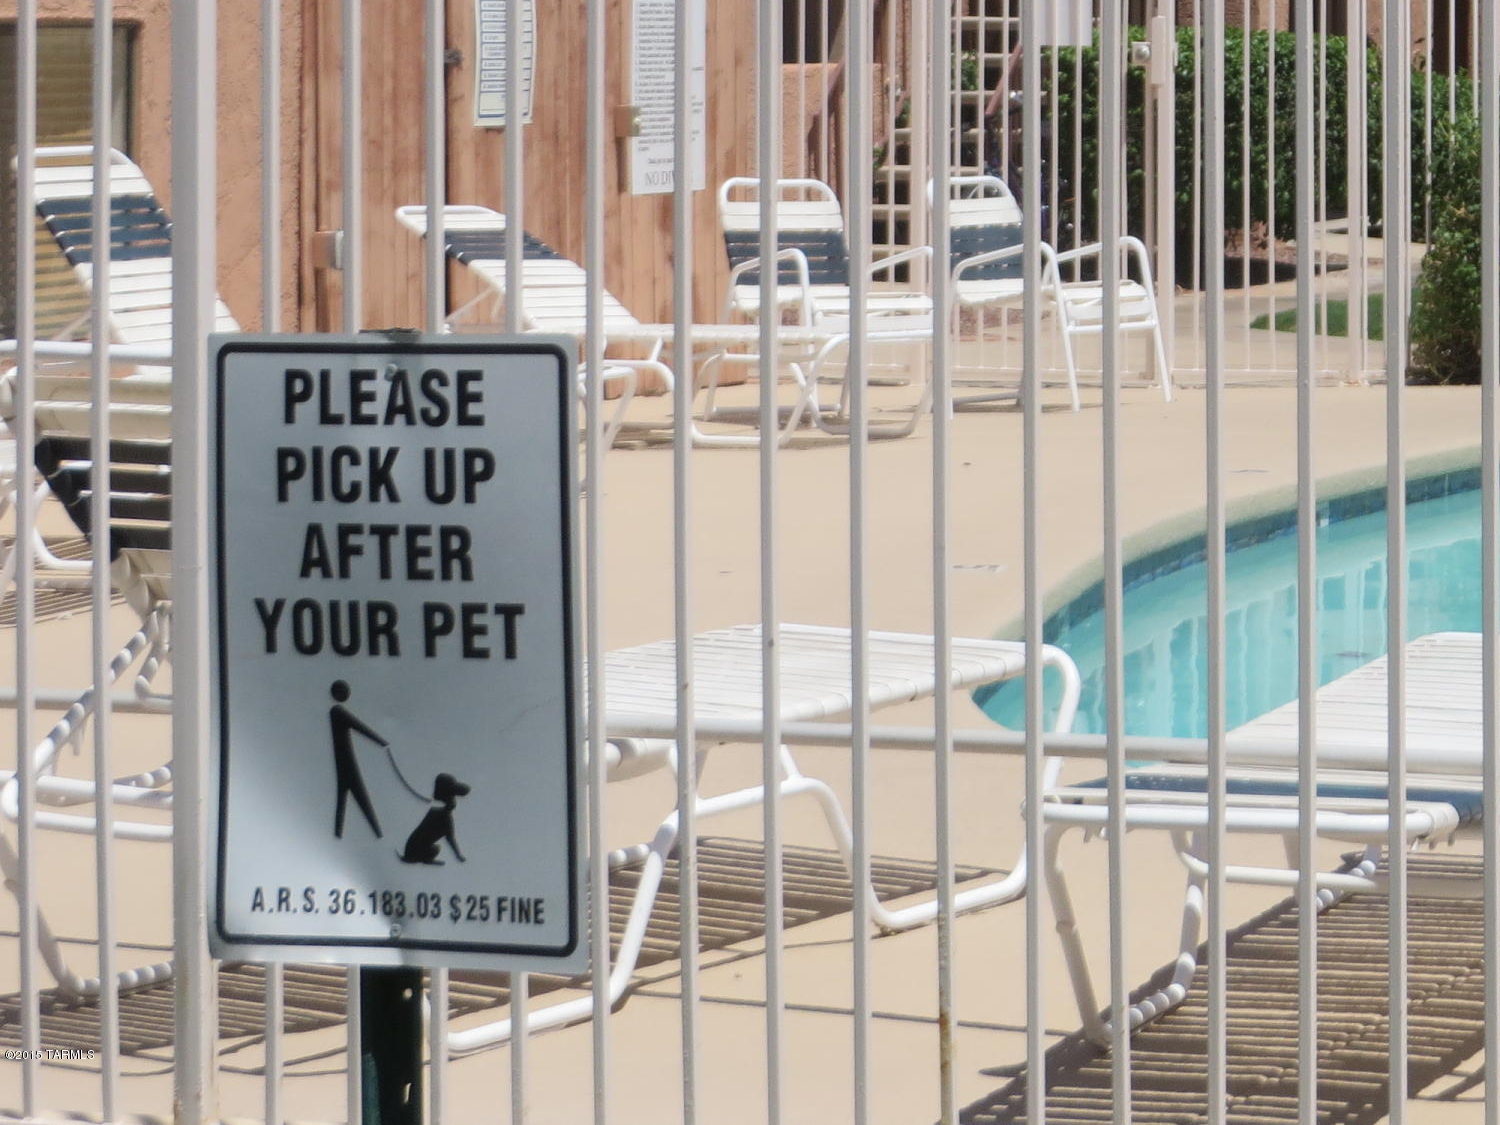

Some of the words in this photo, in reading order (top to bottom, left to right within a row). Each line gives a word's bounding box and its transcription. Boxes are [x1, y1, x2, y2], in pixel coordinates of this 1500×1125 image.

[283, 368, 486, 427] PLEASE
[276, 446, 399, 503] PICK
[424, 448, 496, 504] UP
[300, 523, 474, 581] AFTER
[254, 598, 400, 657] YOUR
[424, 602, 525, 660] PET
[250, 886, 320, 915] A.R.S.
[328, 888, 443, 919] 36.183.03
[449, 894, 490, 924] $25
[496, 896, 545, 925] FINE
